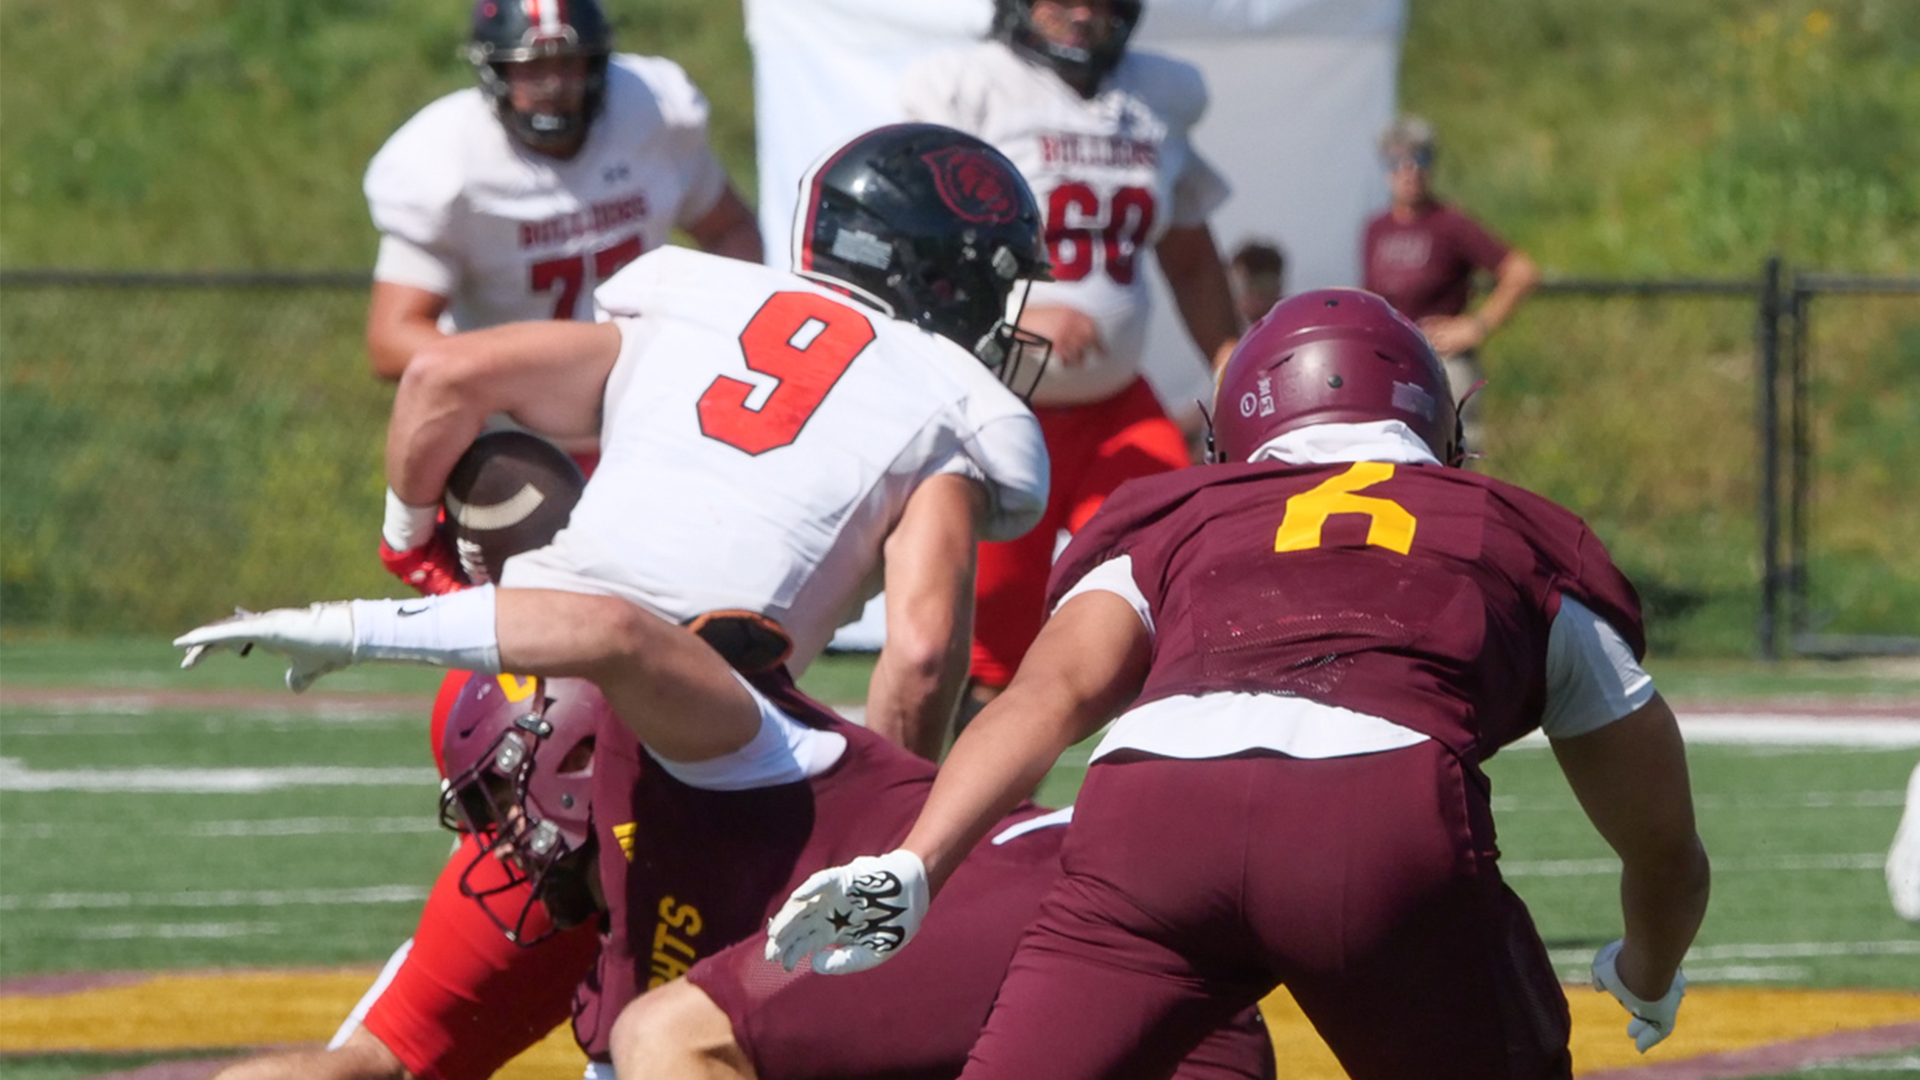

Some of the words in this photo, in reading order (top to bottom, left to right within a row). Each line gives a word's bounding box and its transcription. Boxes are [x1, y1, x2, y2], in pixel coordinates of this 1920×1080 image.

[1046, 182, 1154, 285] 60
[696, 291, 877, 456] 9
[648, 896, 702, 991] HTS
